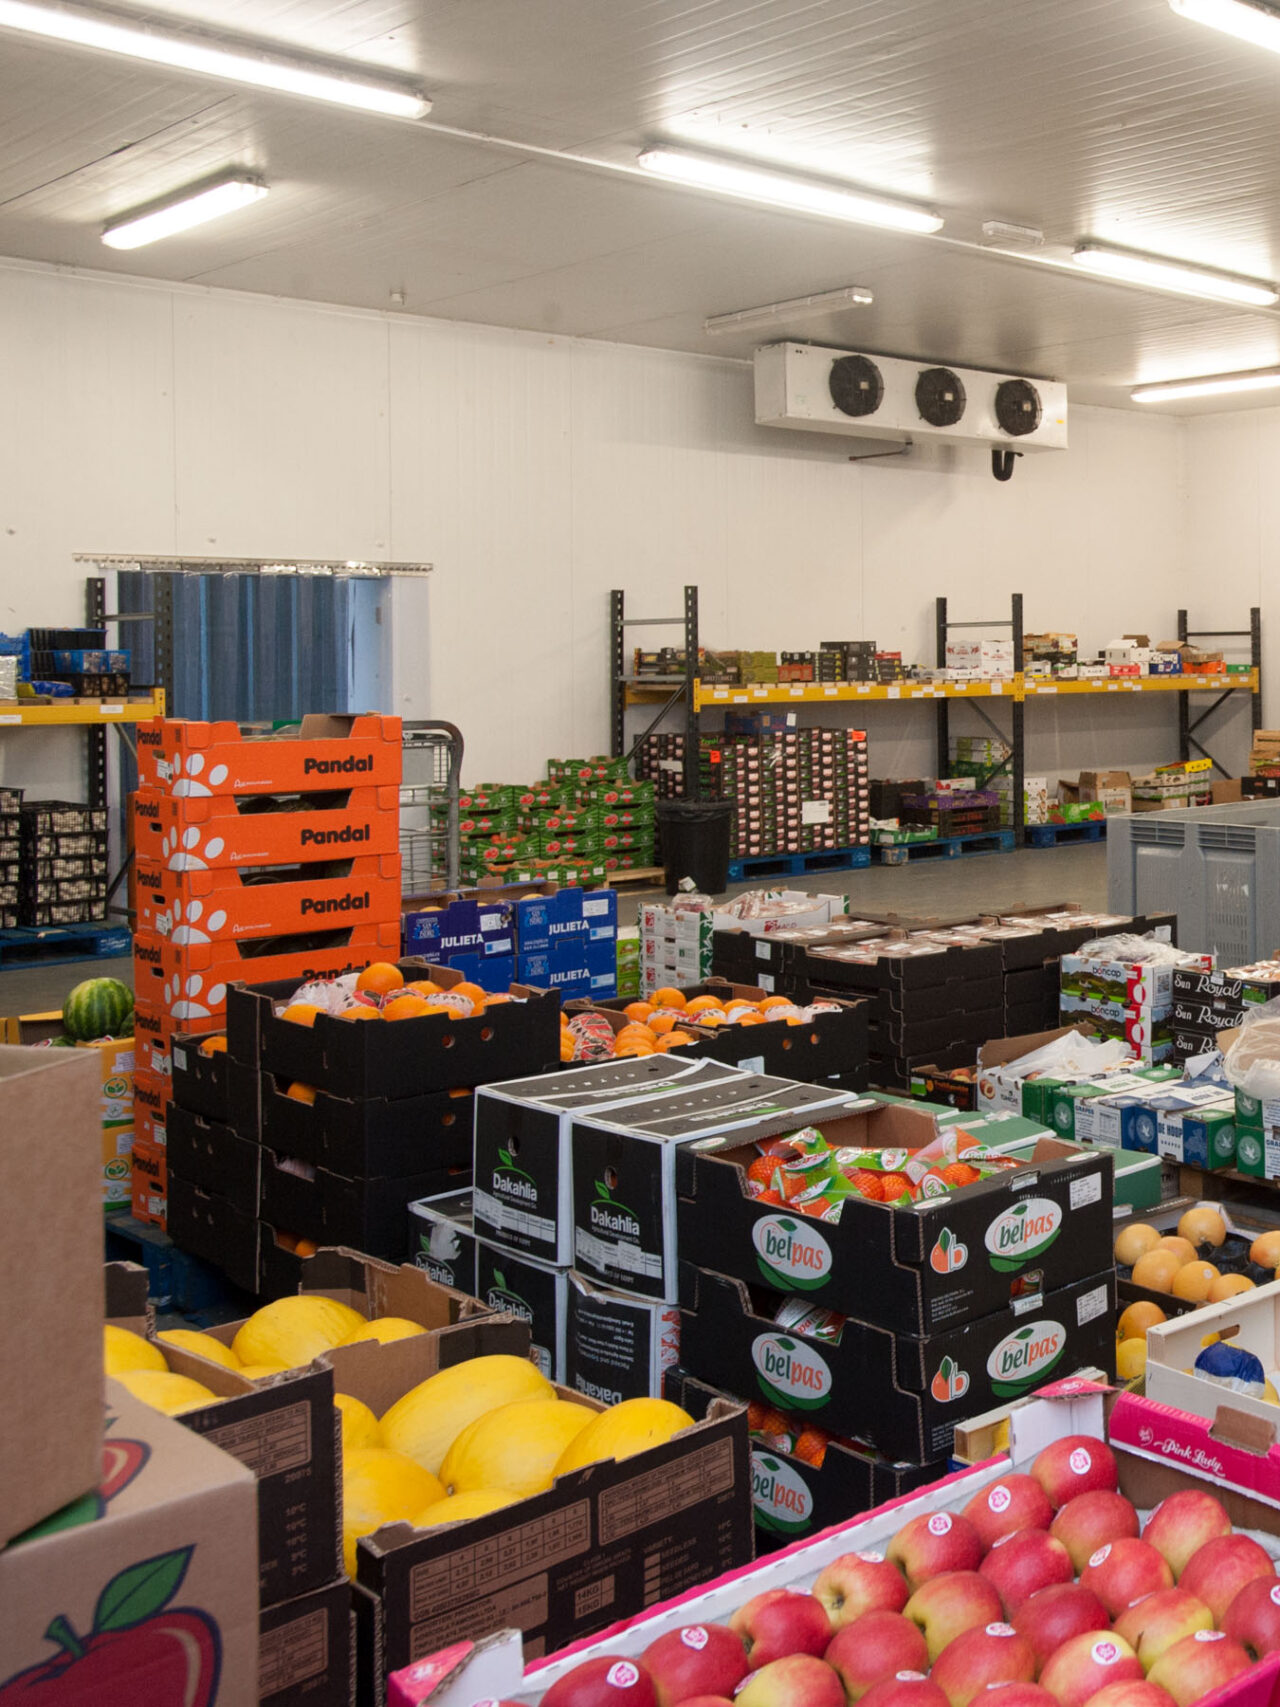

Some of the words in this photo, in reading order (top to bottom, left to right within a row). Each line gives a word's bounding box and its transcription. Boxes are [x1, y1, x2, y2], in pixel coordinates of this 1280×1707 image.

[304, 754, 374, 775] Pandal
[301, 823, 370, 846] Pandal
[301, 891, 370, 915] Pandal
[549, 919, 590, 936] JULIETA
[440, 933, 485, 950] JULIETA
[550, 968, 591, 985] JULIETA
[1174, 973, 1191, 990] Sun
[1196, 975, 1243, 999] Royal
[1175, 1004, 1192, 1021] Sun
[1197, 1005, 1245, 1028] Royal
[1176, 1034, 1194, 1051] Sun
[1166, 1123, 1183, 1138] HOOP
[492, 1171, 538, 1202] Dakahlia
[590, 1203, 640, 1237] Dakahlia
[999, 1211, 1055, 1250] belpas
[765, 1229, 824, 1271] belpas
[1001, 1332, 1060, 1375] belpas
[765, 1346, 824, 1392] belpas
[1153, 1437, 1193, 1460] Pink
[1191, 1448, 1226, 1478] Lady
